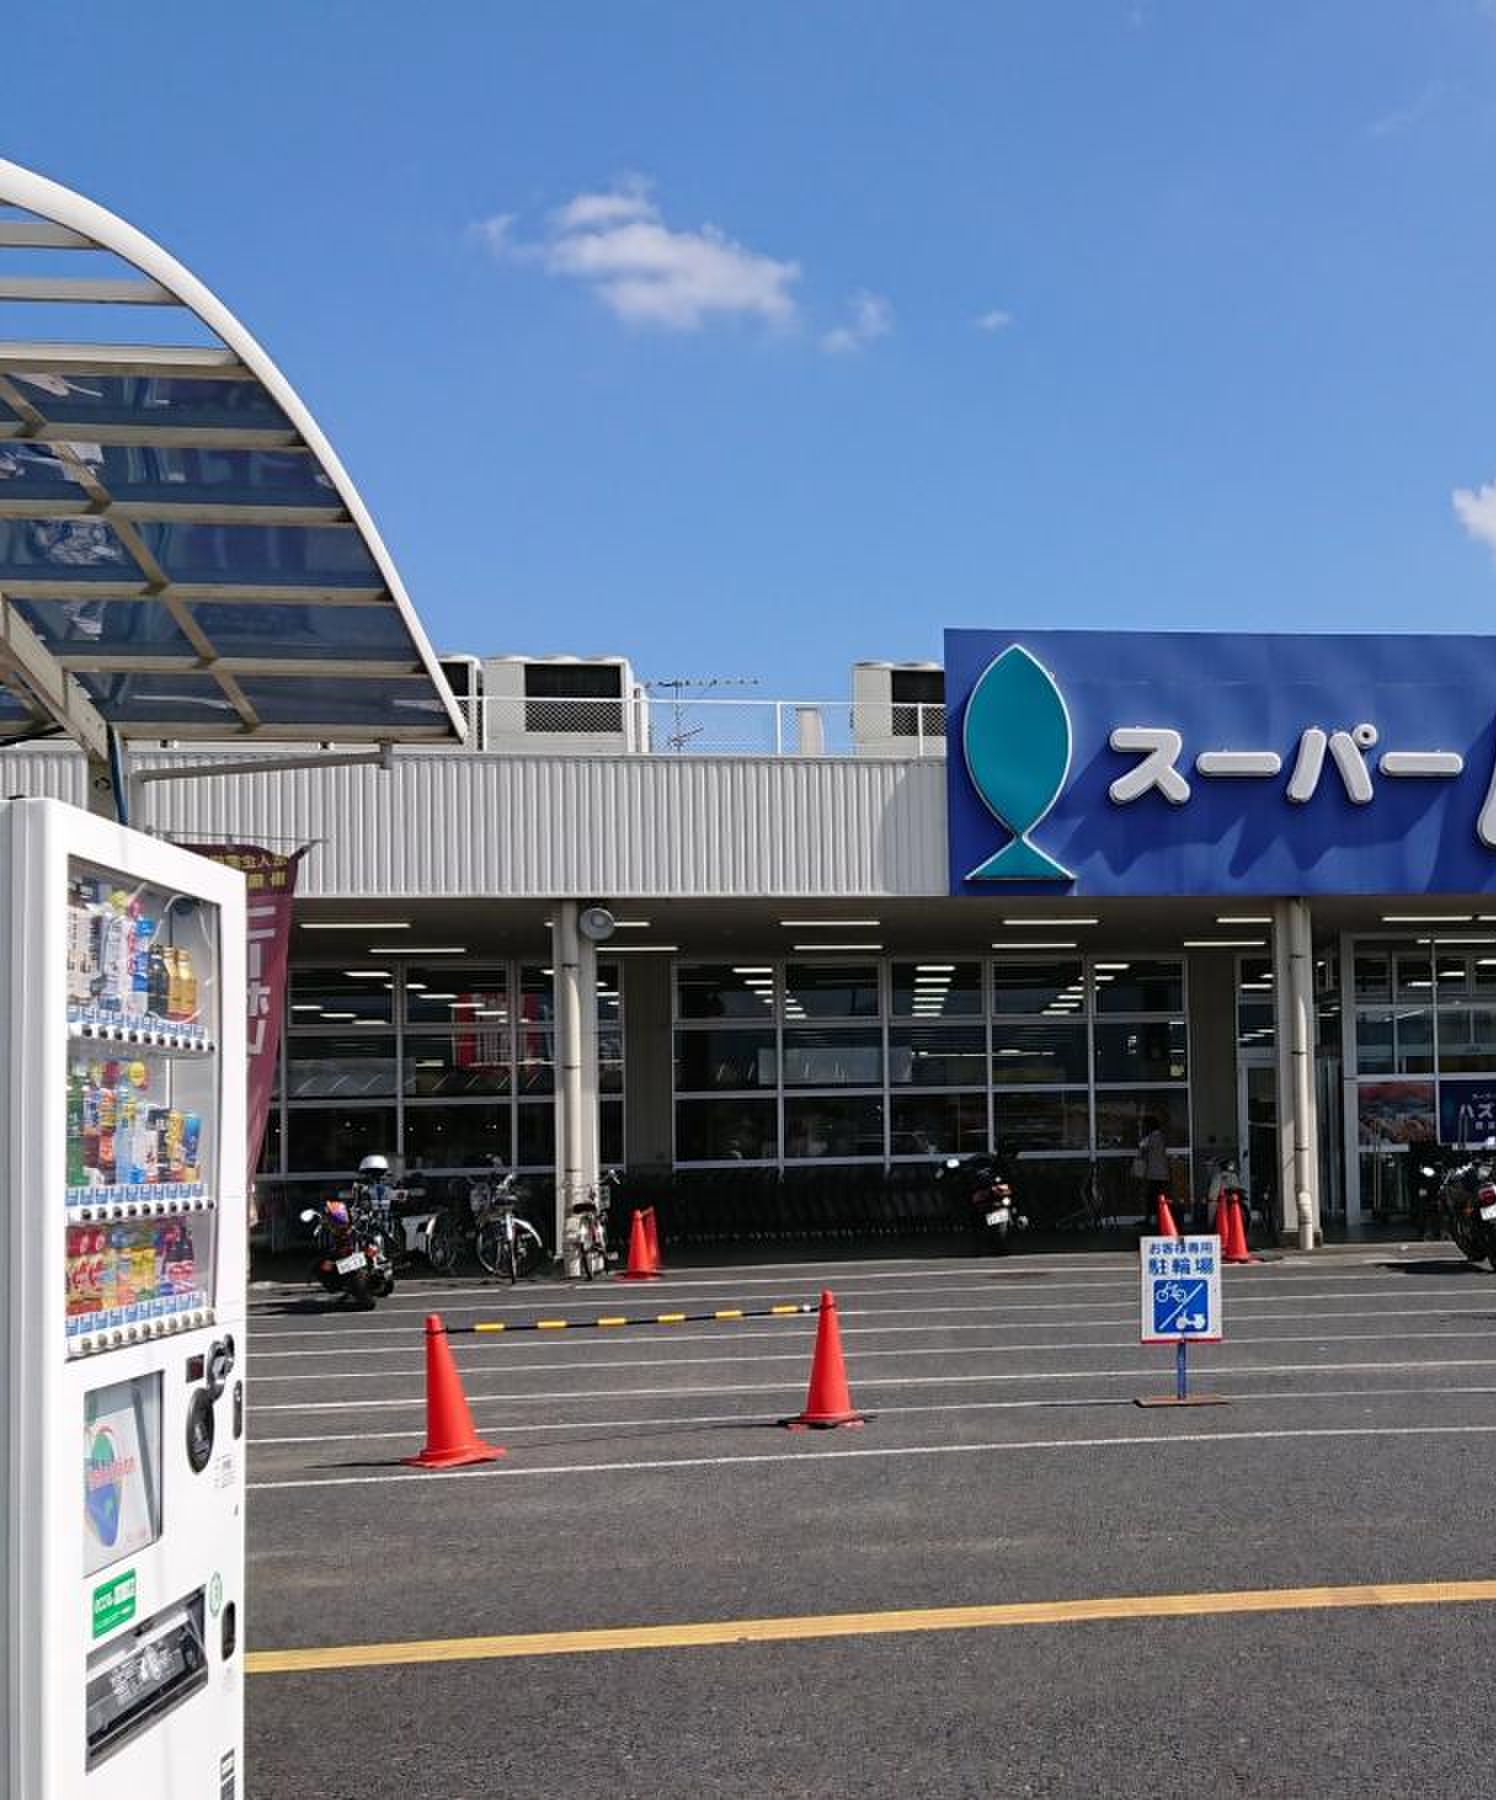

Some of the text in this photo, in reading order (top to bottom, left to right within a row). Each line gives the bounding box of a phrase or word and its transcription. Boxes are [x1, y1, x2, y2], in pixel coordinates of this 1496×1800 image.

[1108, 724, 1463, 805] スーパー
[1148, 1256, 1216, 1275] 駐輪場
